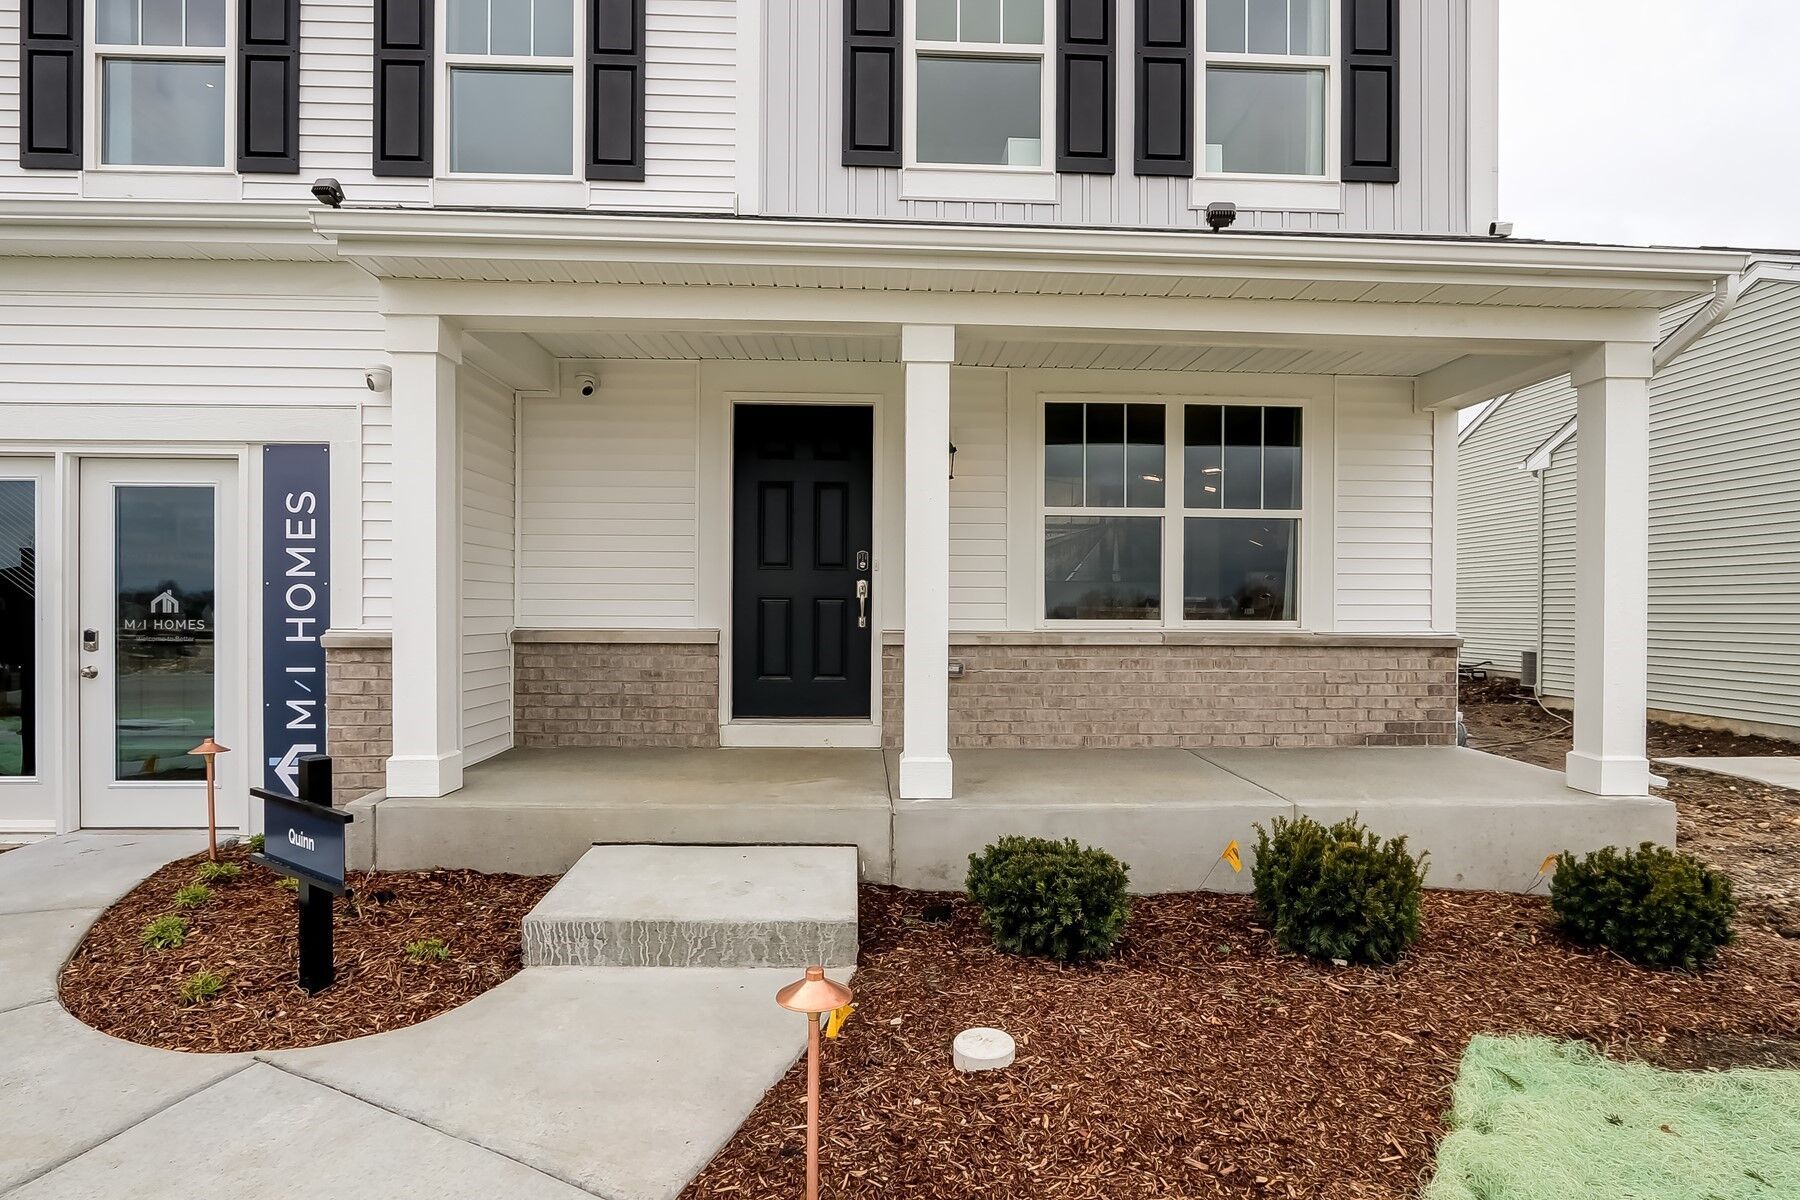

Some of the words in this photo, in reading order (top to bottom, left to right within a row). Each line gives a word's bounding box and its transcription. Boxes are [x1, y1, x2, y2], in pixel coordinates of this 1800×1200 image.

[285, 491, 316, 641] HOMES
[124, 619, 147, 630] M/I
[153, 619, 205, 630] HOMES
[285, 667, 316, 729] M/I
[288, 828, 315, 851] Quinn
